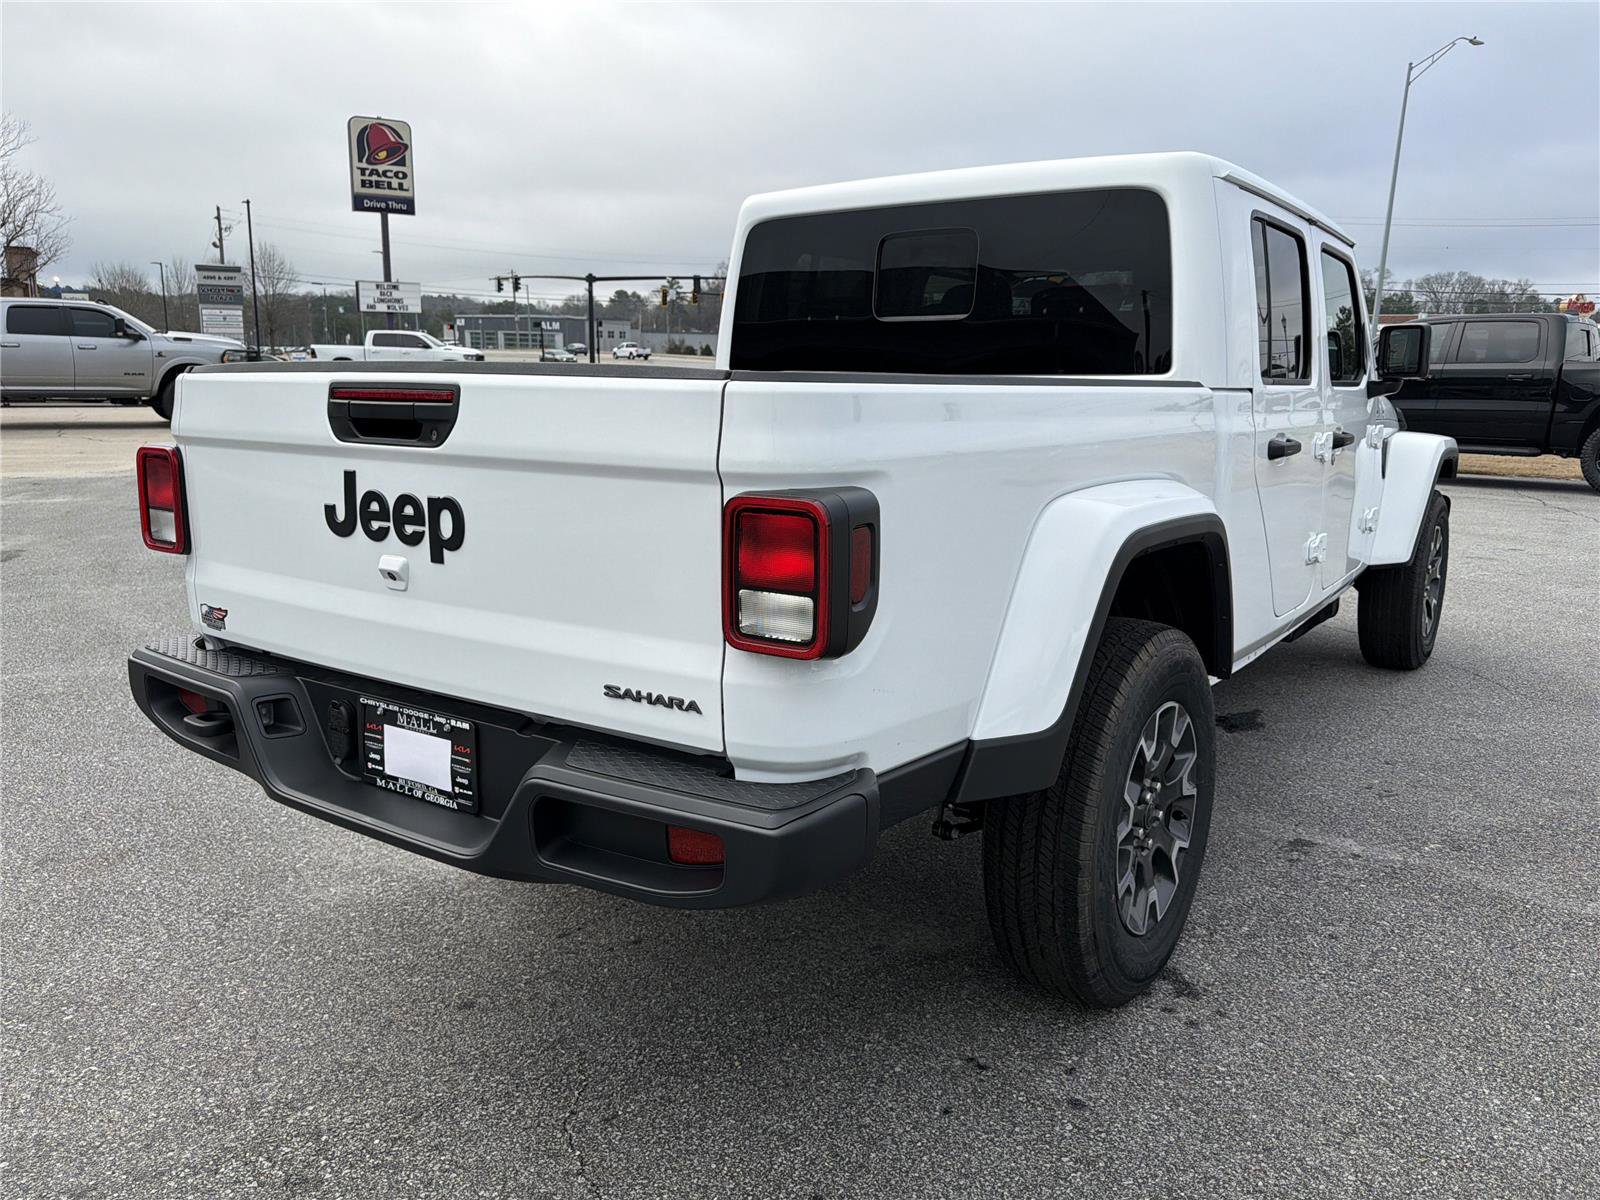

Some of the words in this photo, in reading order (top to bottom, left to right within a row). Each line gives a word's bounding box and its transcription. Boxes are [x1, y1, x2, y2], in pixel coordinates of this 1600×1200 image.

[356, 166, 408, 180] TACO
[360, 179, 410, 192] BELL
[363, 199, 386, 208] Drive
[388, 201, 407, 210] Thru
[376, 283, 400, 291] WELCOME
[373, 296, 405, 304] LONGHORNS
[541, 321, 560, 330] ALM
[324, 469, 466, 565] Jeep
[603, 683, 703, 715] SAHARA
[360, 698, 399, 711] CHRYSLER
[403, 708, 430, 719] DODGE
[433, 713, 447, 724] Jeep
[450, 719, 470, 730] RAM
[412, 789, 424, 799] OF
[424, 792, 459, 810] GEORGIA
